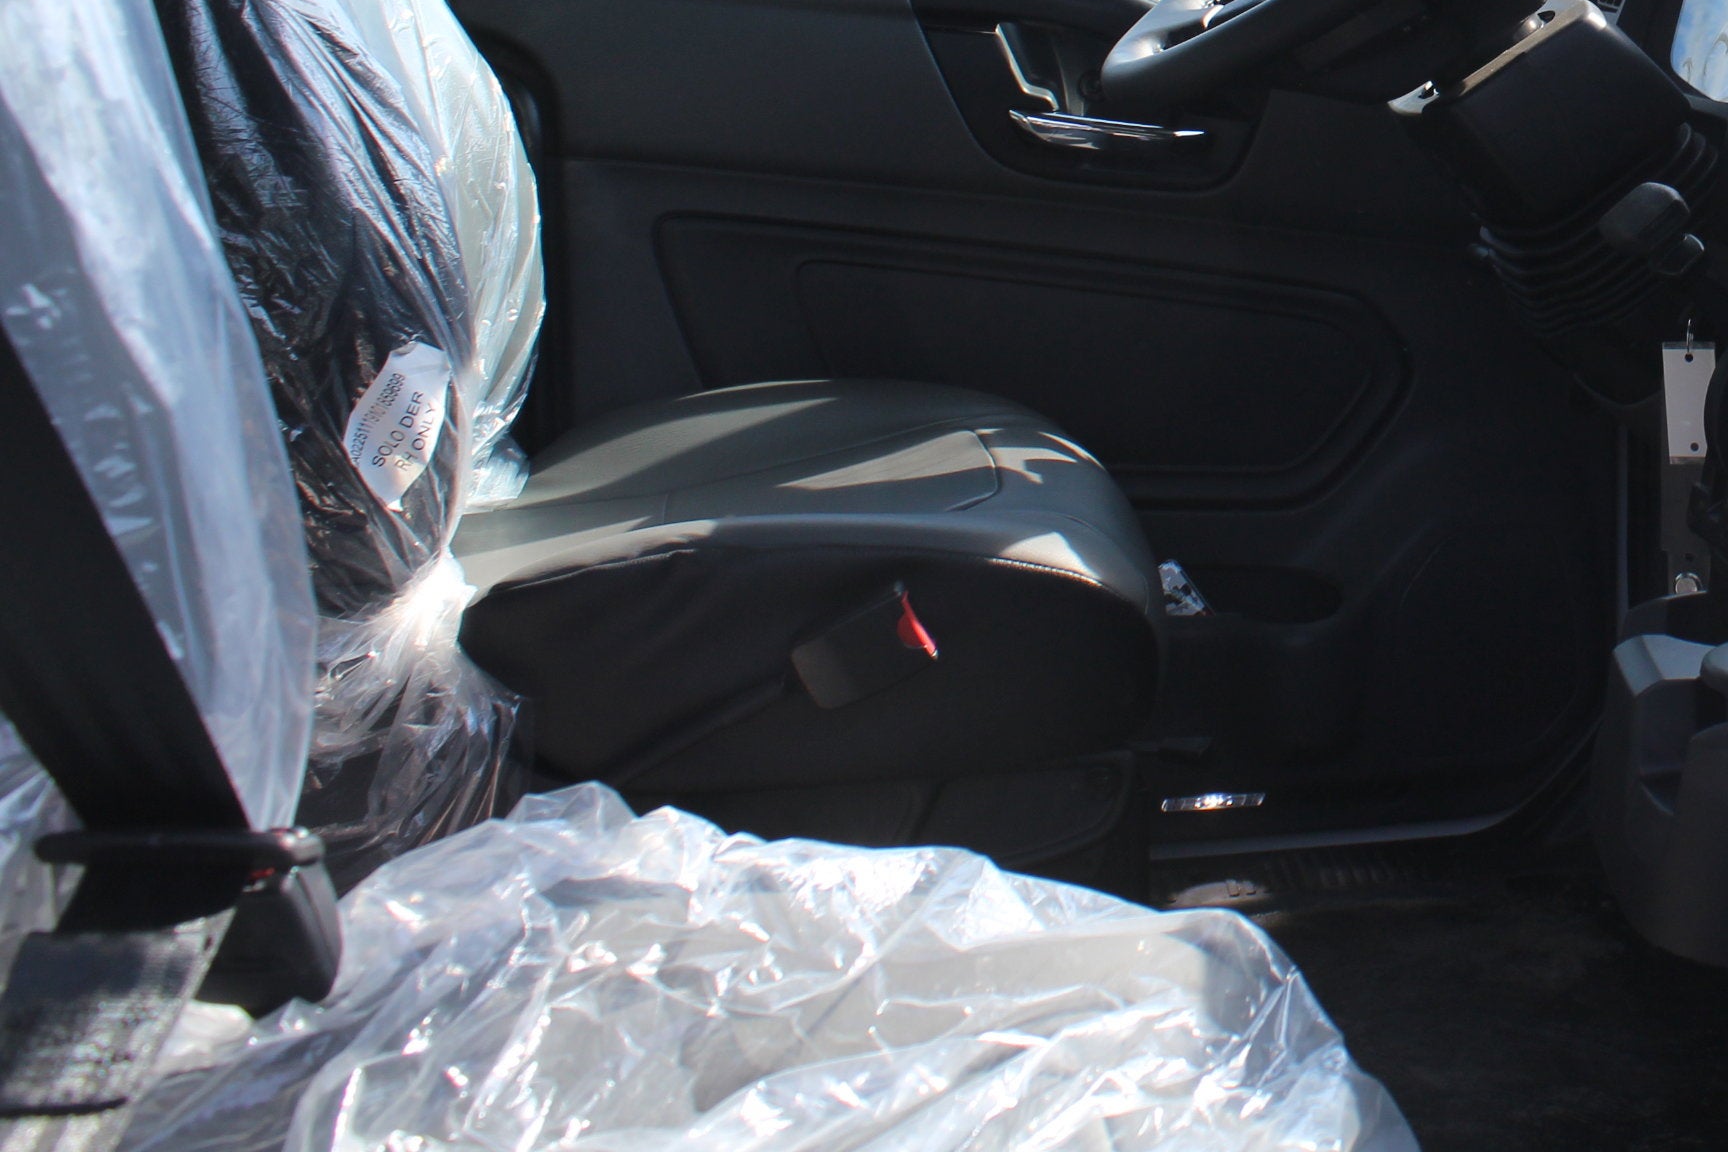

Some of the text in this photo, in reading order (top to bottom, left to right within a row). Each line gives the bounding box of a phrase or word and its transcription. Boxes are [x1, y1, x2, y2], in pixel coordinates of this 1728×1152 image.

[372, 391, 424, 468] SOLO DER
[395, 402, 436, 472] RH ONLY
